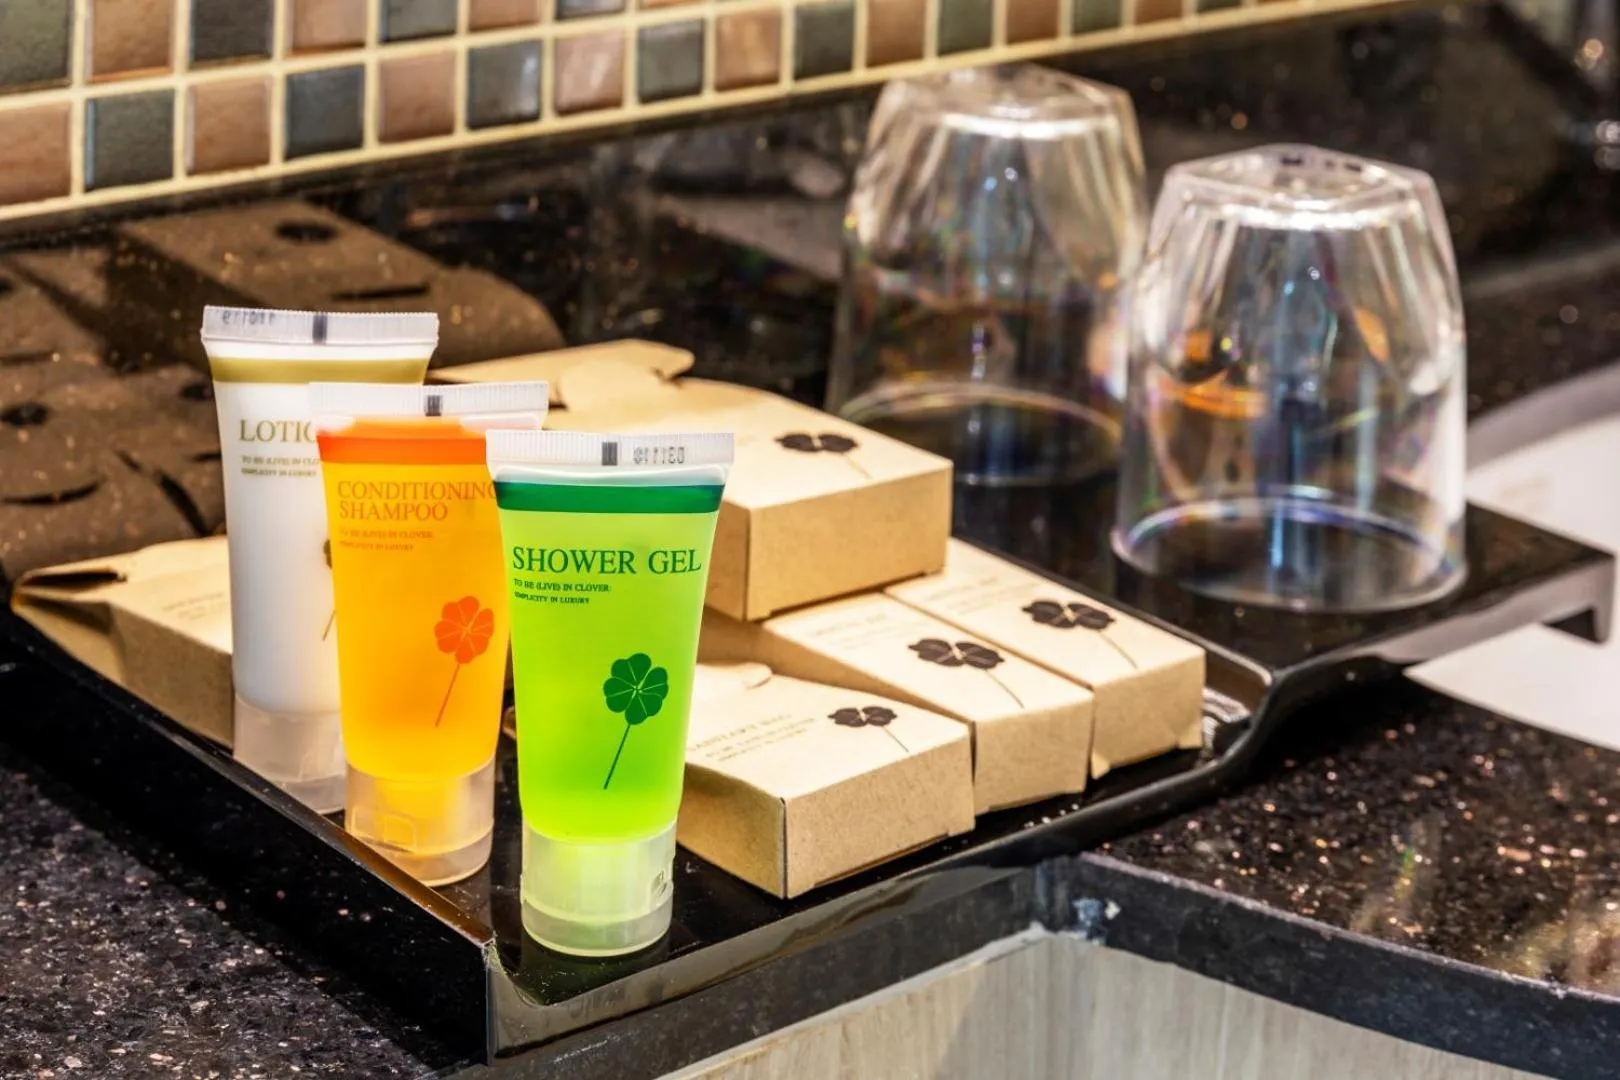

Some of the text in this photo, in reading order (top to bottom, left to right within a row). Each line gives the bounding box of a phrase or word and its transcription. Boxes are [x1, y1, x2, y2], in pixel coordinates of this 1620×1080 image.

[339, 501, 448, 521] SHAMPOO
[512, 546, 702, 575] SHOWER GEL
[514, 578, 523, 587] TO
[524, 580, 534, 589] BE
[563, 583, 573, 592] IN
